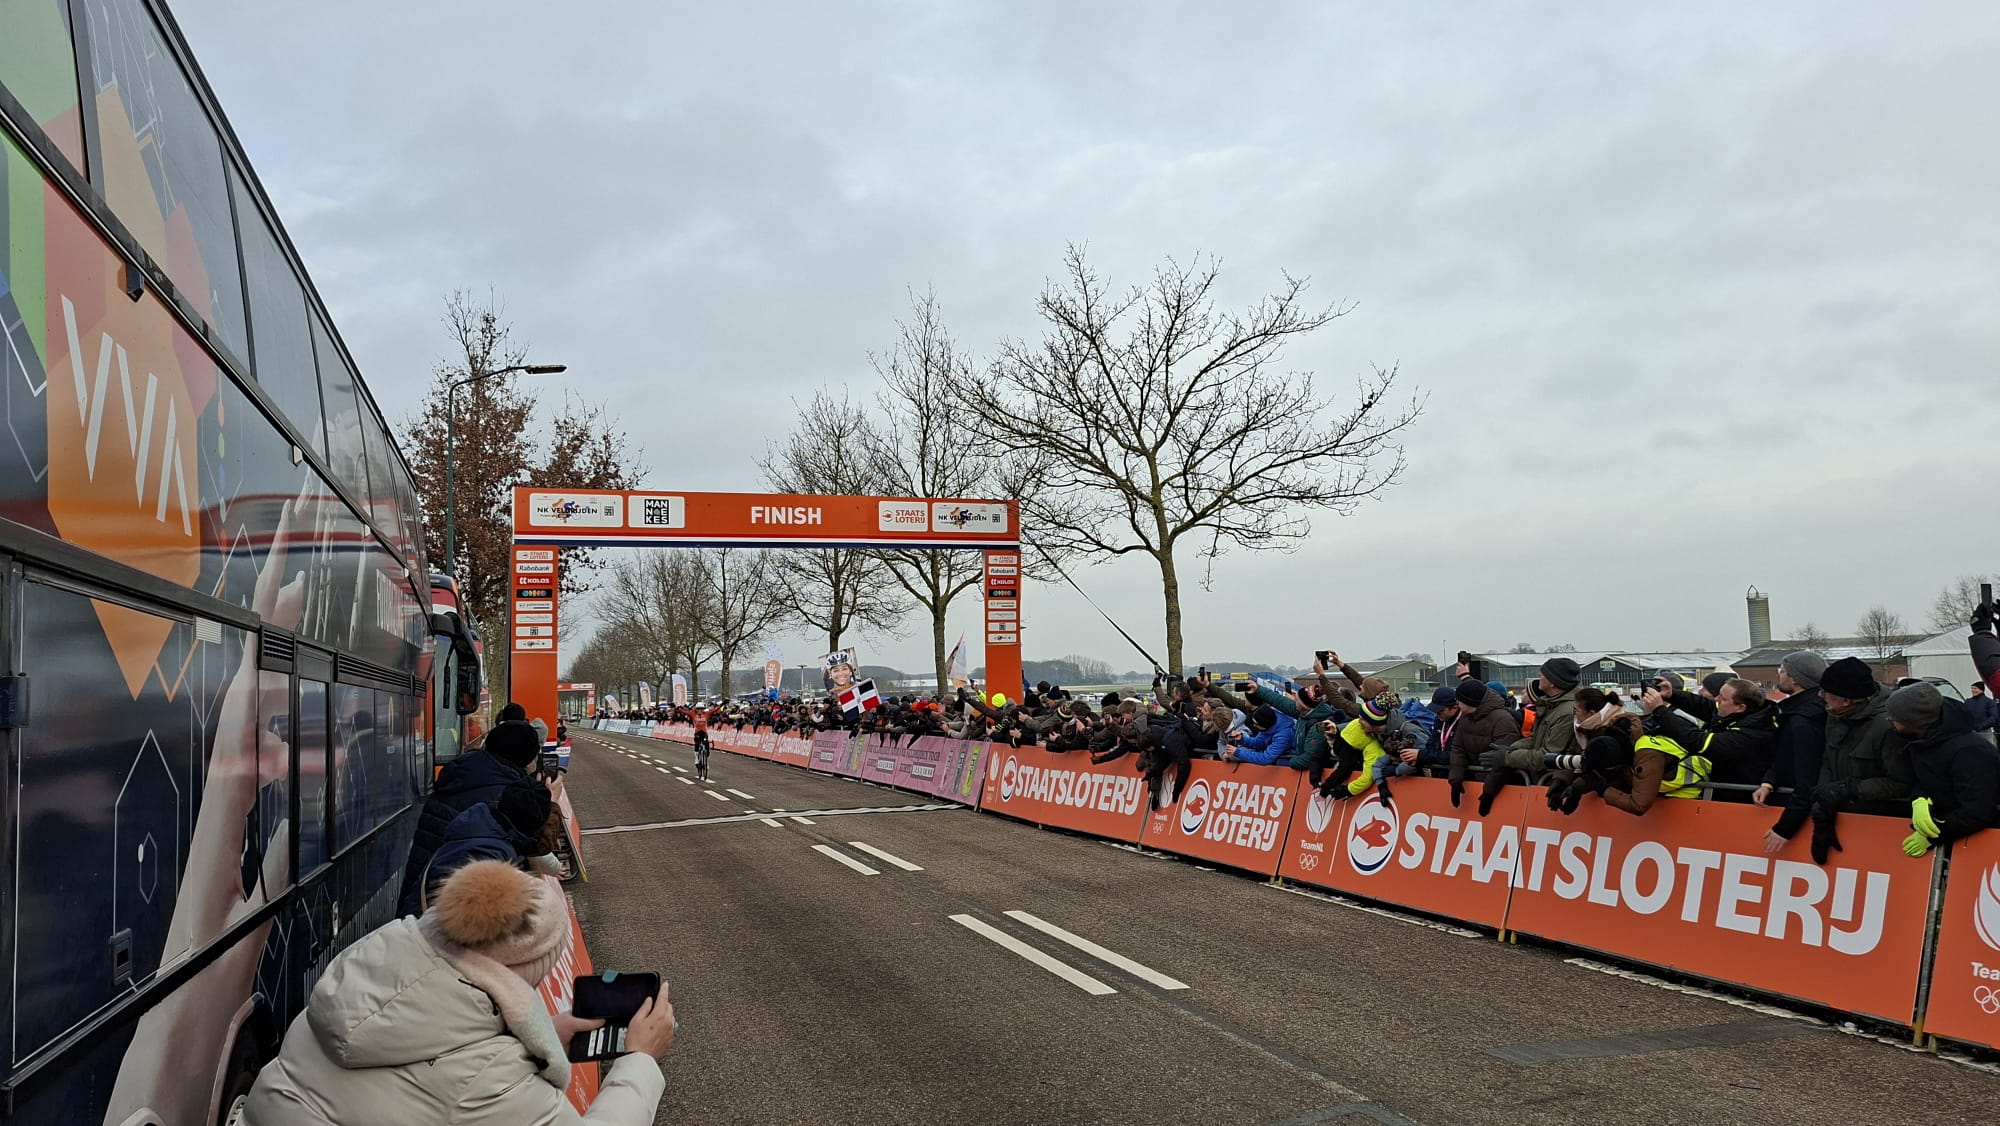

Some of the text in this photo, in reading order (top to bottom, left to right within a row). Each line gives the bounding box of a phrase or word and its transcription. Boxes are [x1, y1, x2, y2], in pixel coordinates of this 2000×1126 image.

[646, 500, 668, 508] MAN
[646, 515, 668, 524] KES
[751, 506, 822, 525] FINISH
[895, 516, 926, 524] LOTERIJ
[1015, 764, 1143, 816] STAATSLOTERIJ
[1212, 781, 1287, 818] STAATS
[1203, 810, 1280, 852] LOTERIJ
[1300, 839, 1324, 852] TeamNL
[1399, 812, 1890, 956] STAATSLOTERIJ
